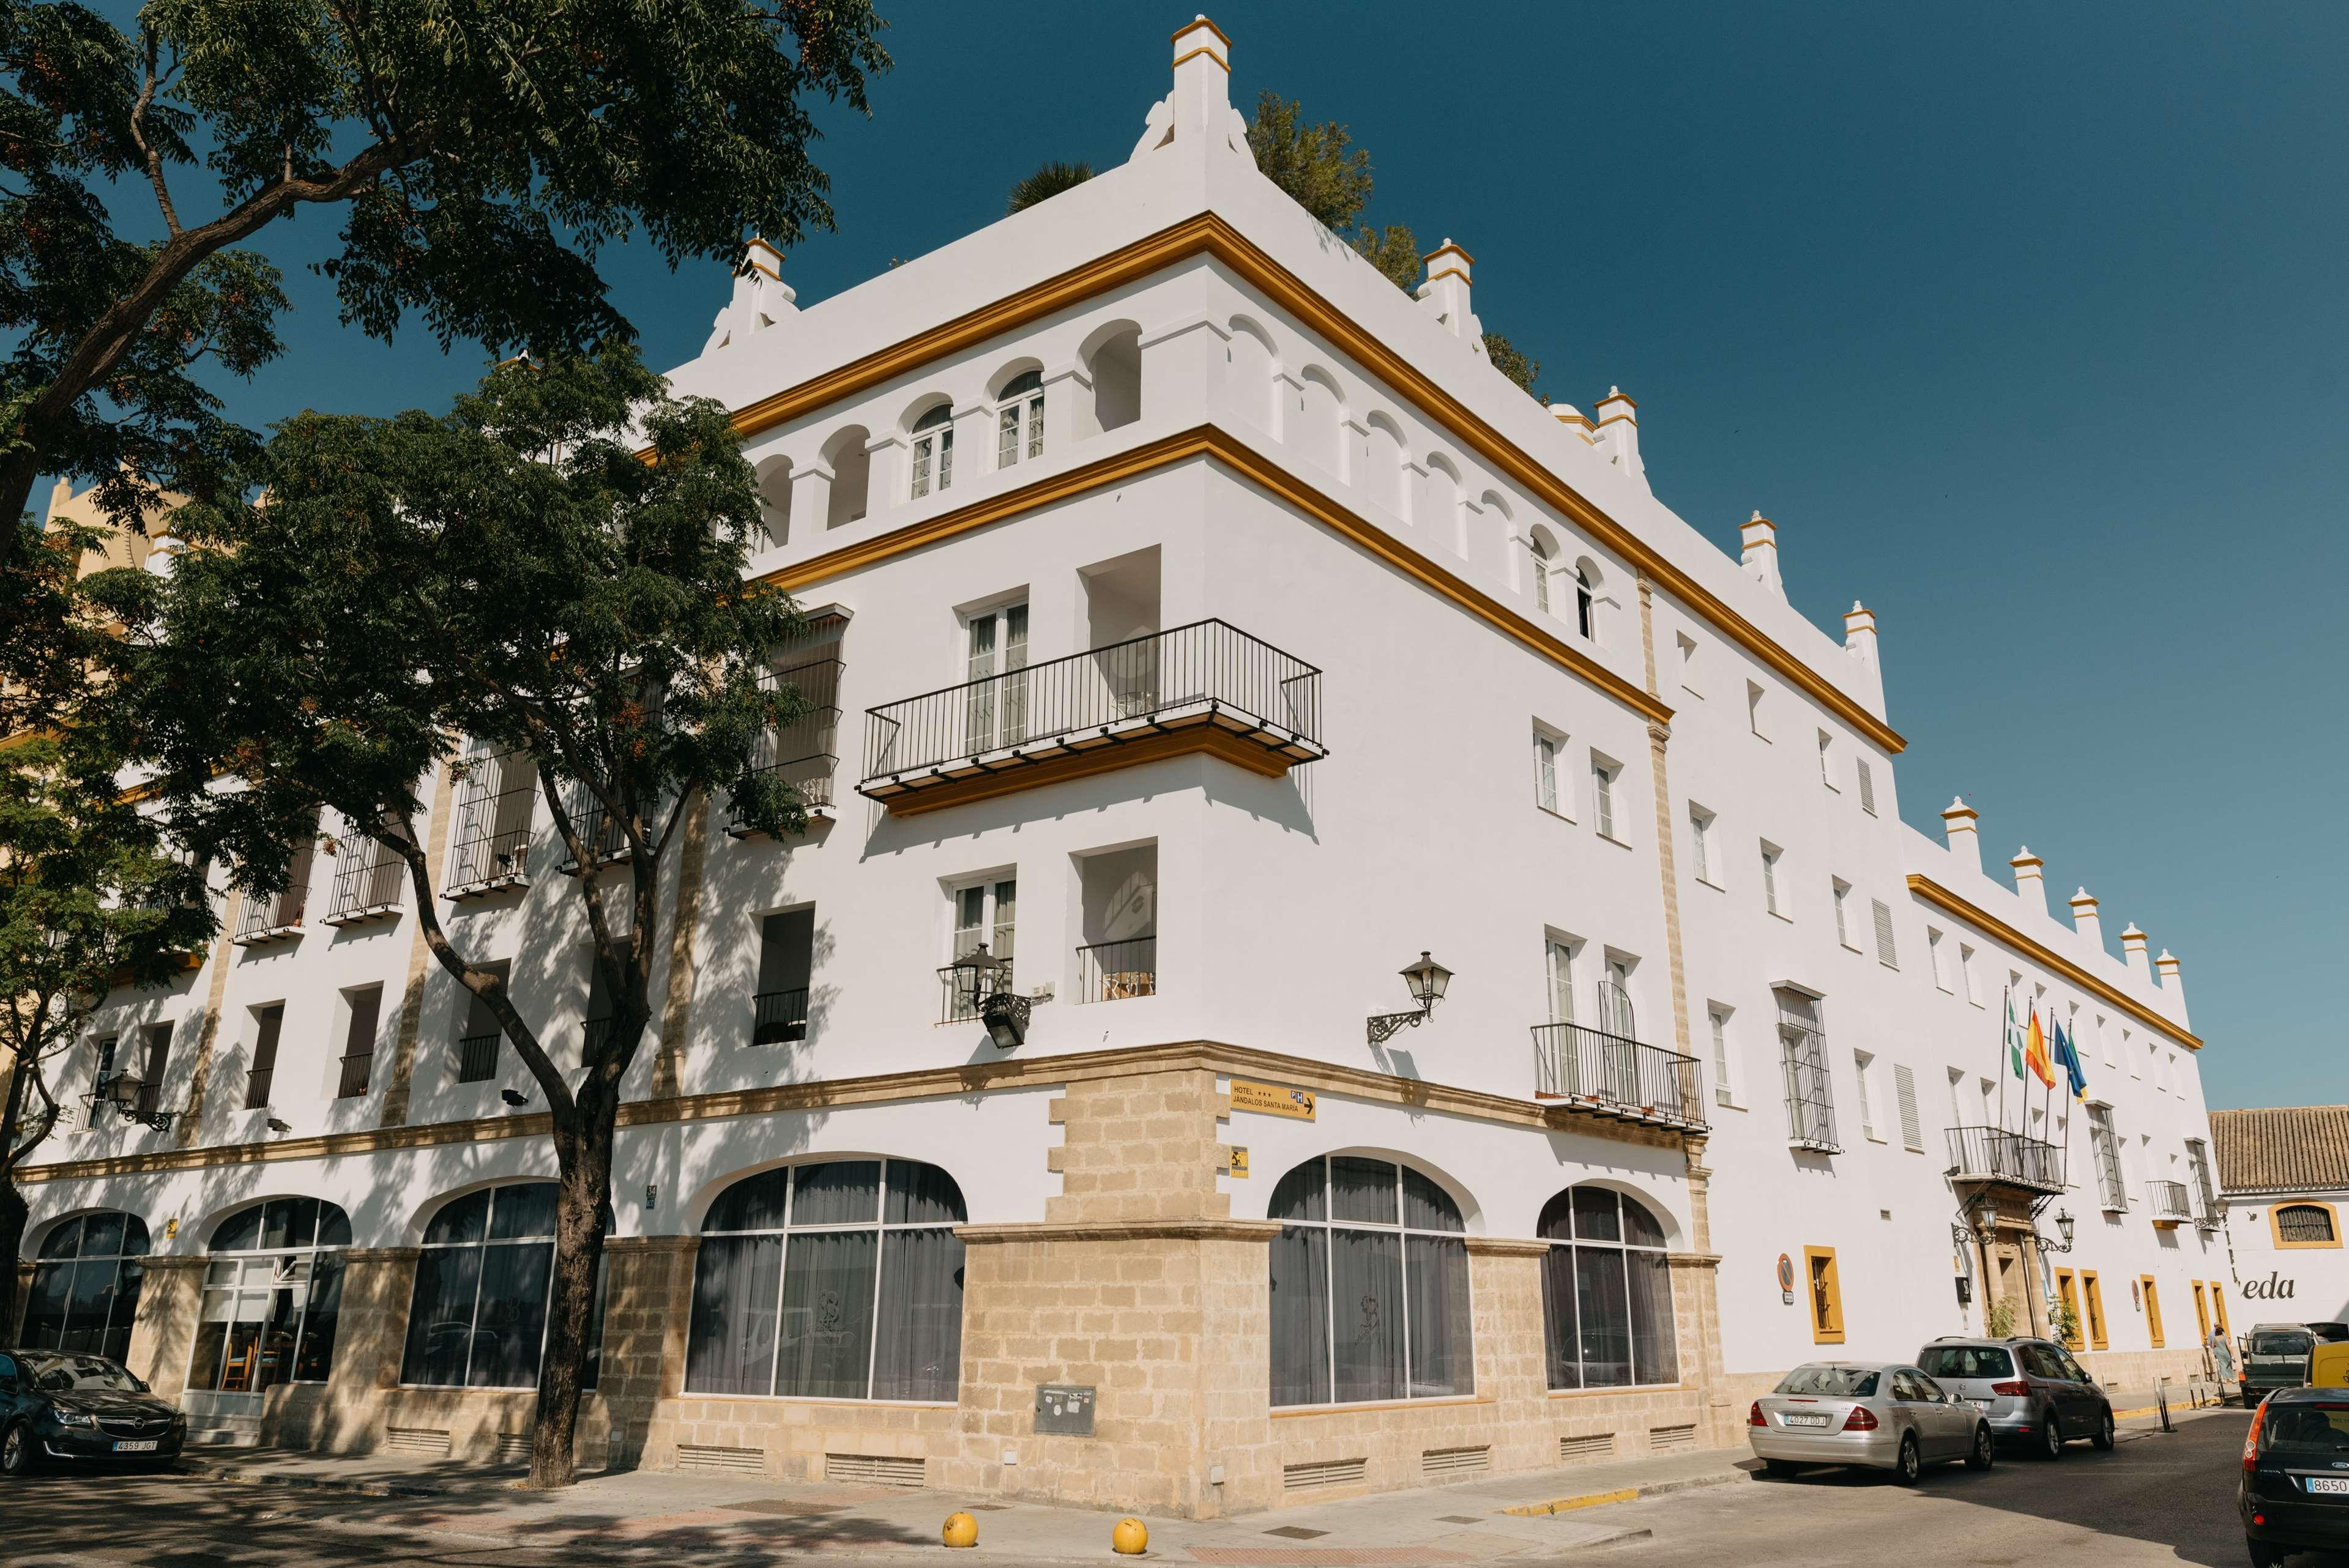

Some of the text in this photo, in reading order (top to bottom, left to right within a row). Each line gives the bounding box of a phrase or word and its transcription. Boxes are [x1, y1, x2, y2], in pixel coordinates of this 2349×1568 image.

[1234, 1086, 1254, 1095] HOTEL
[1233, 1094, 1298, 1112] JÁNDALOS SANTA MARÍA
[1297, 1092, 1303, 1103] H
[2314, 1480, 2347, 1492] 8650
